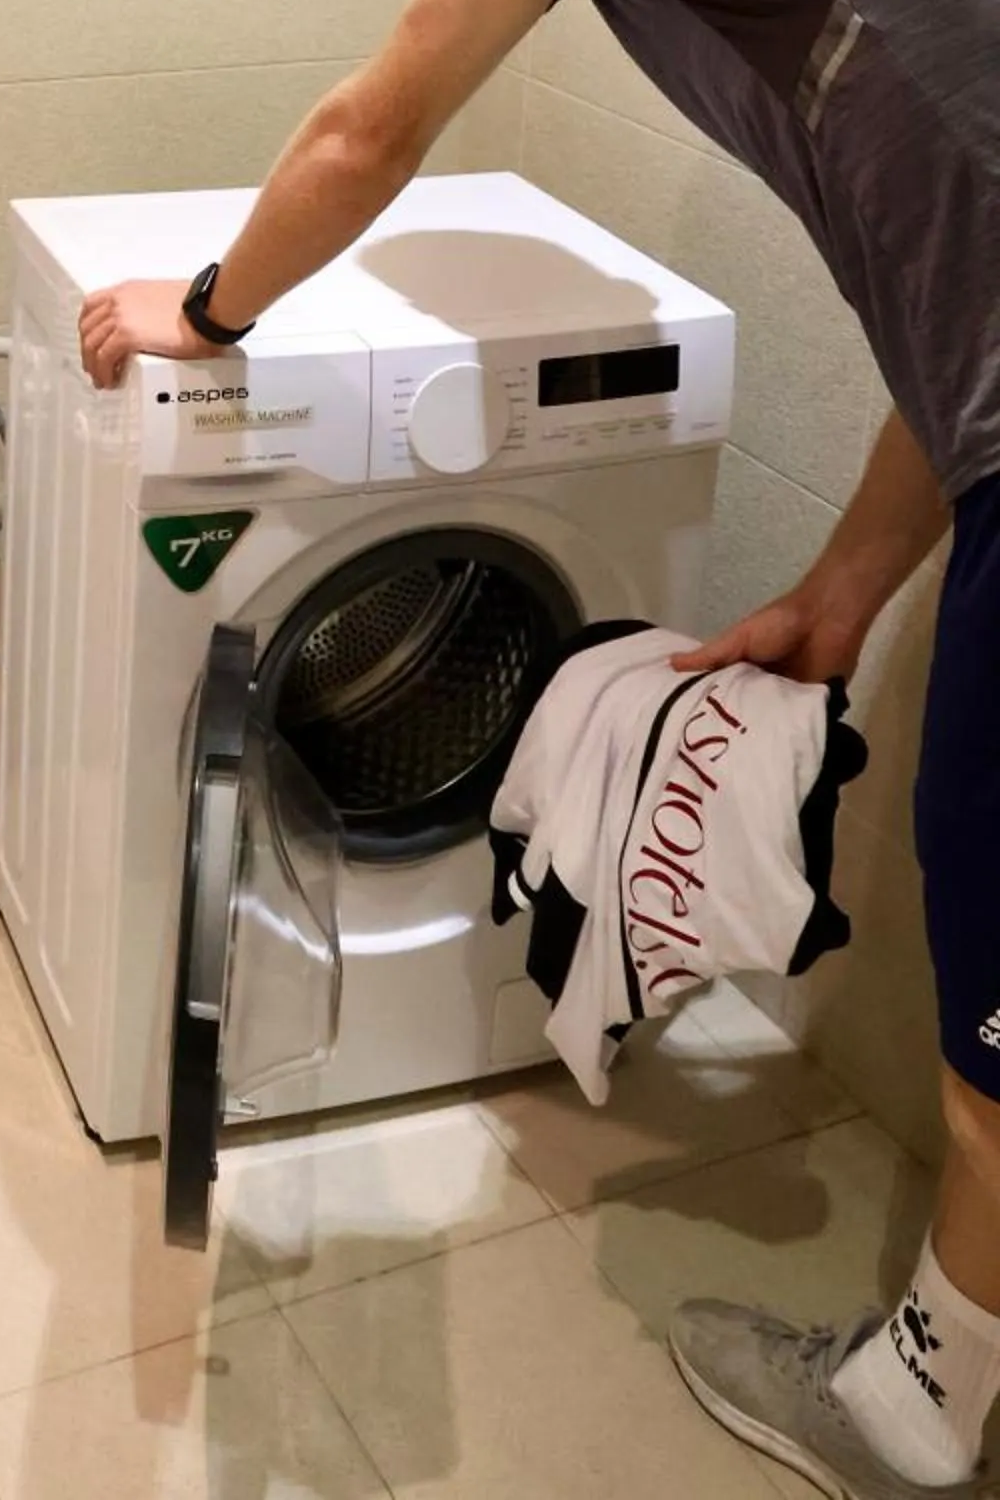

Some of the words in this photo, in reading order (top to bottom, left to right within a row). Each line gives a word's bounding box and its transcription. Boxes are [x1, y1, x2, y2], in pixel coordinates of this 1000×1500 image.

[177, 387, 249, 404] aspes
[194, 409, 252, 428] WASHING
[257, 406, 313, 422] MACHINE
[170, 537, 201, 568] 7
[201, 528, 233, 542] KG
